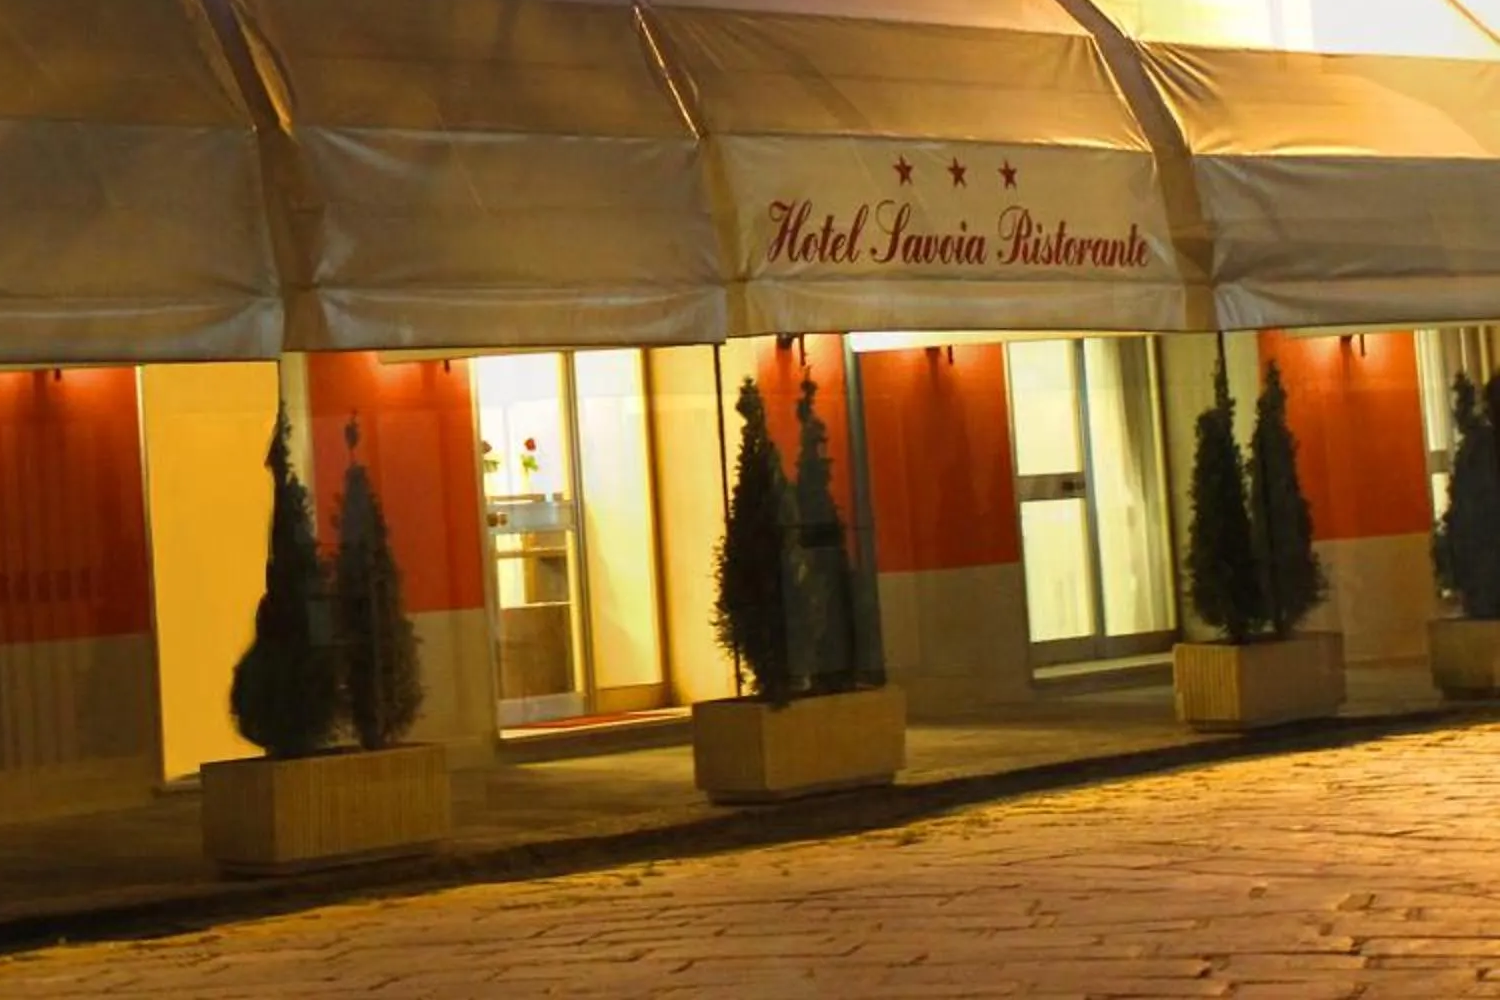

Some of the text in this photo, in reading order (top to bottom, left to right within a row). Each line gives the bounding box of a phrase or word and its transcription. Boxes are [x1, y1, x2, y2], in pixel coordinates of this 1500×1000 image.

[767, 198, 1151, 268] Hotel Savoia Ristorante
